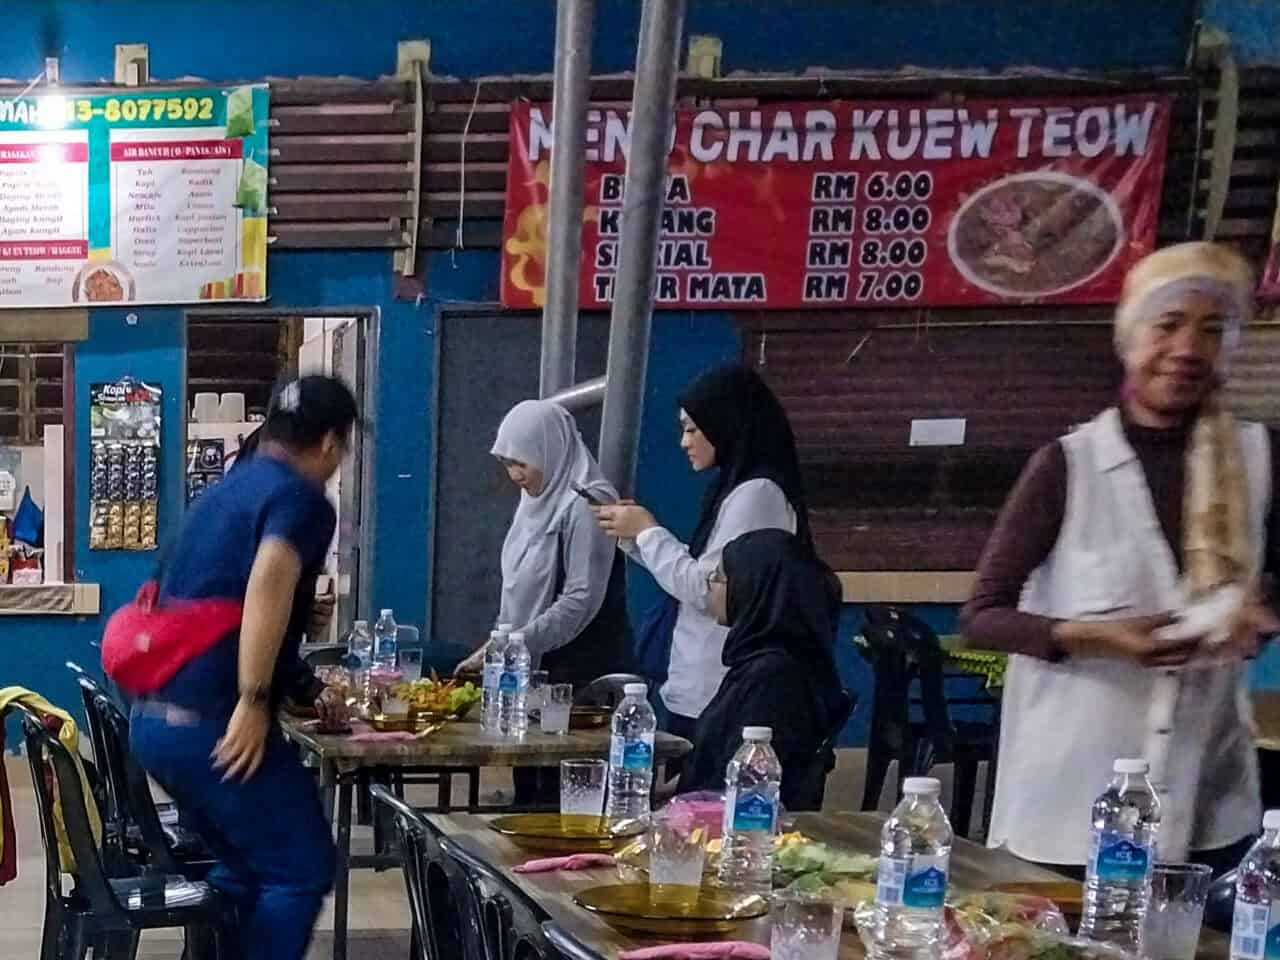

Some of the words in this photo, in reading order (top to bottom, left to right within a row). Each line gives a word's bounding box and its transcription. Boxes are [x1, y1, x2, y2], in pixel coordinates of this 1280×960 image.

[64, 97, 213, 122] 13-8077592
[690, 109, 837, 163] CHAR
[849, 108, 999, 161] KUEW
[1009, 101, 1157, 160] TEOW
[812, 172, 859, 202] RM
[864, 170, 933, 202] 6.00
[597, 206, 715, 235] KANG
[809, 206, 856, 235] RM
[862, 204, 931, 234] 8.00
[595, 240, 711, 269] SIAL
[806, 239, 852, 269] RM
[860, 237, 928, 268] 8.00
[686, 272, 767, 303] MATA
[803, 271, 849, 302] RM
[856, 271, 924, 301] 7.00
